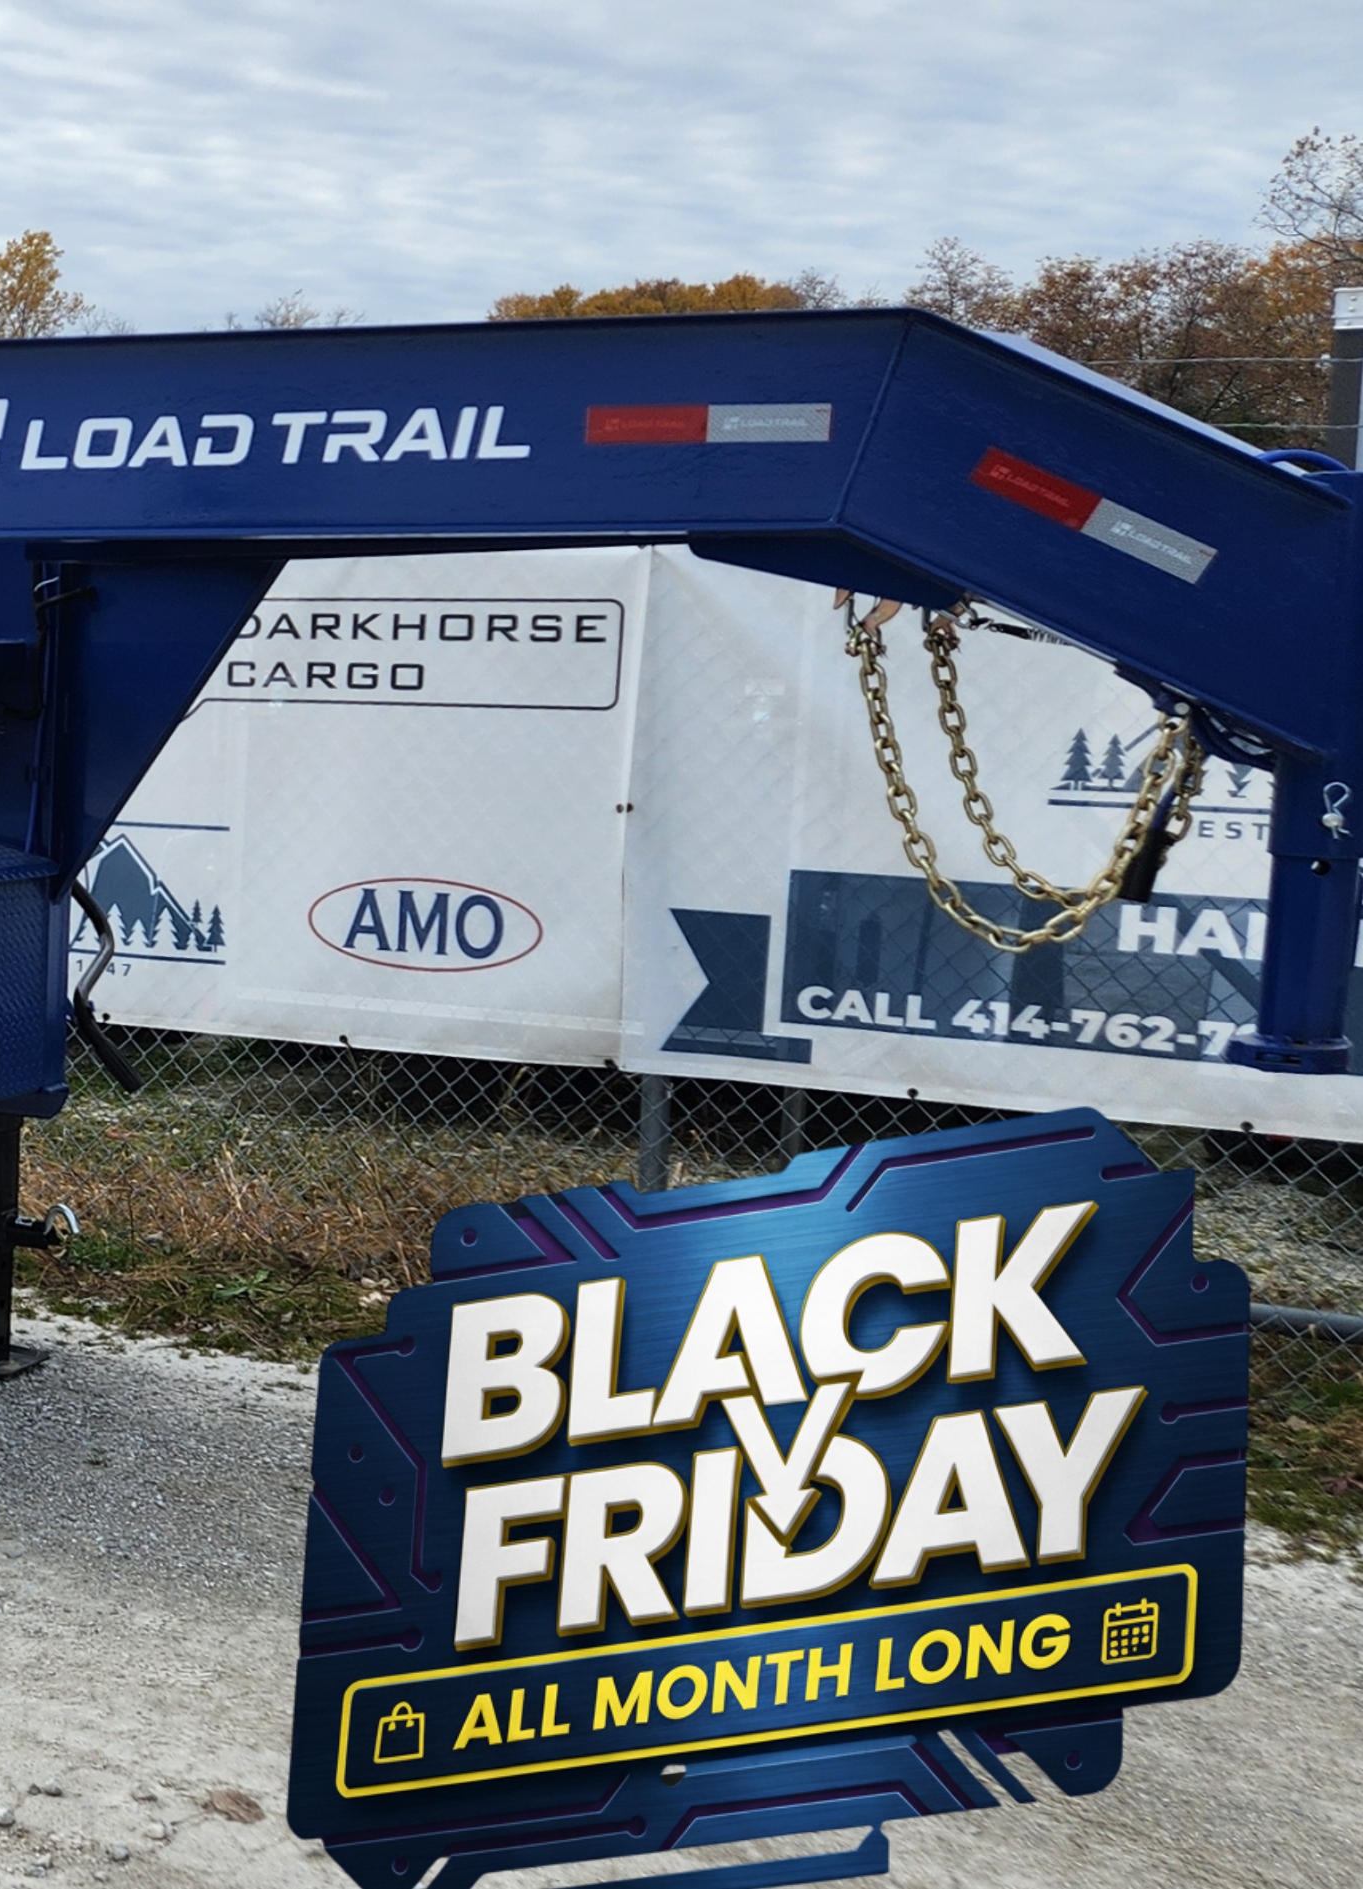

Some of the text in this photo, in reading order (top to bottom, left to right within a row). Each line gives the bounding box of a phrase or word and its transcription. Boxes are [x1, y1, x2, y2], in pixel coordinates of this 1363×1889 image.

[20, 406, 532, 470] LOAD TRAIL
[227, 661, 424, 690] CARGO
[342, 887, 504, 959] AMO
[76, 959, 132, 977] 147
[797, 986, 936, 1030] CALL
